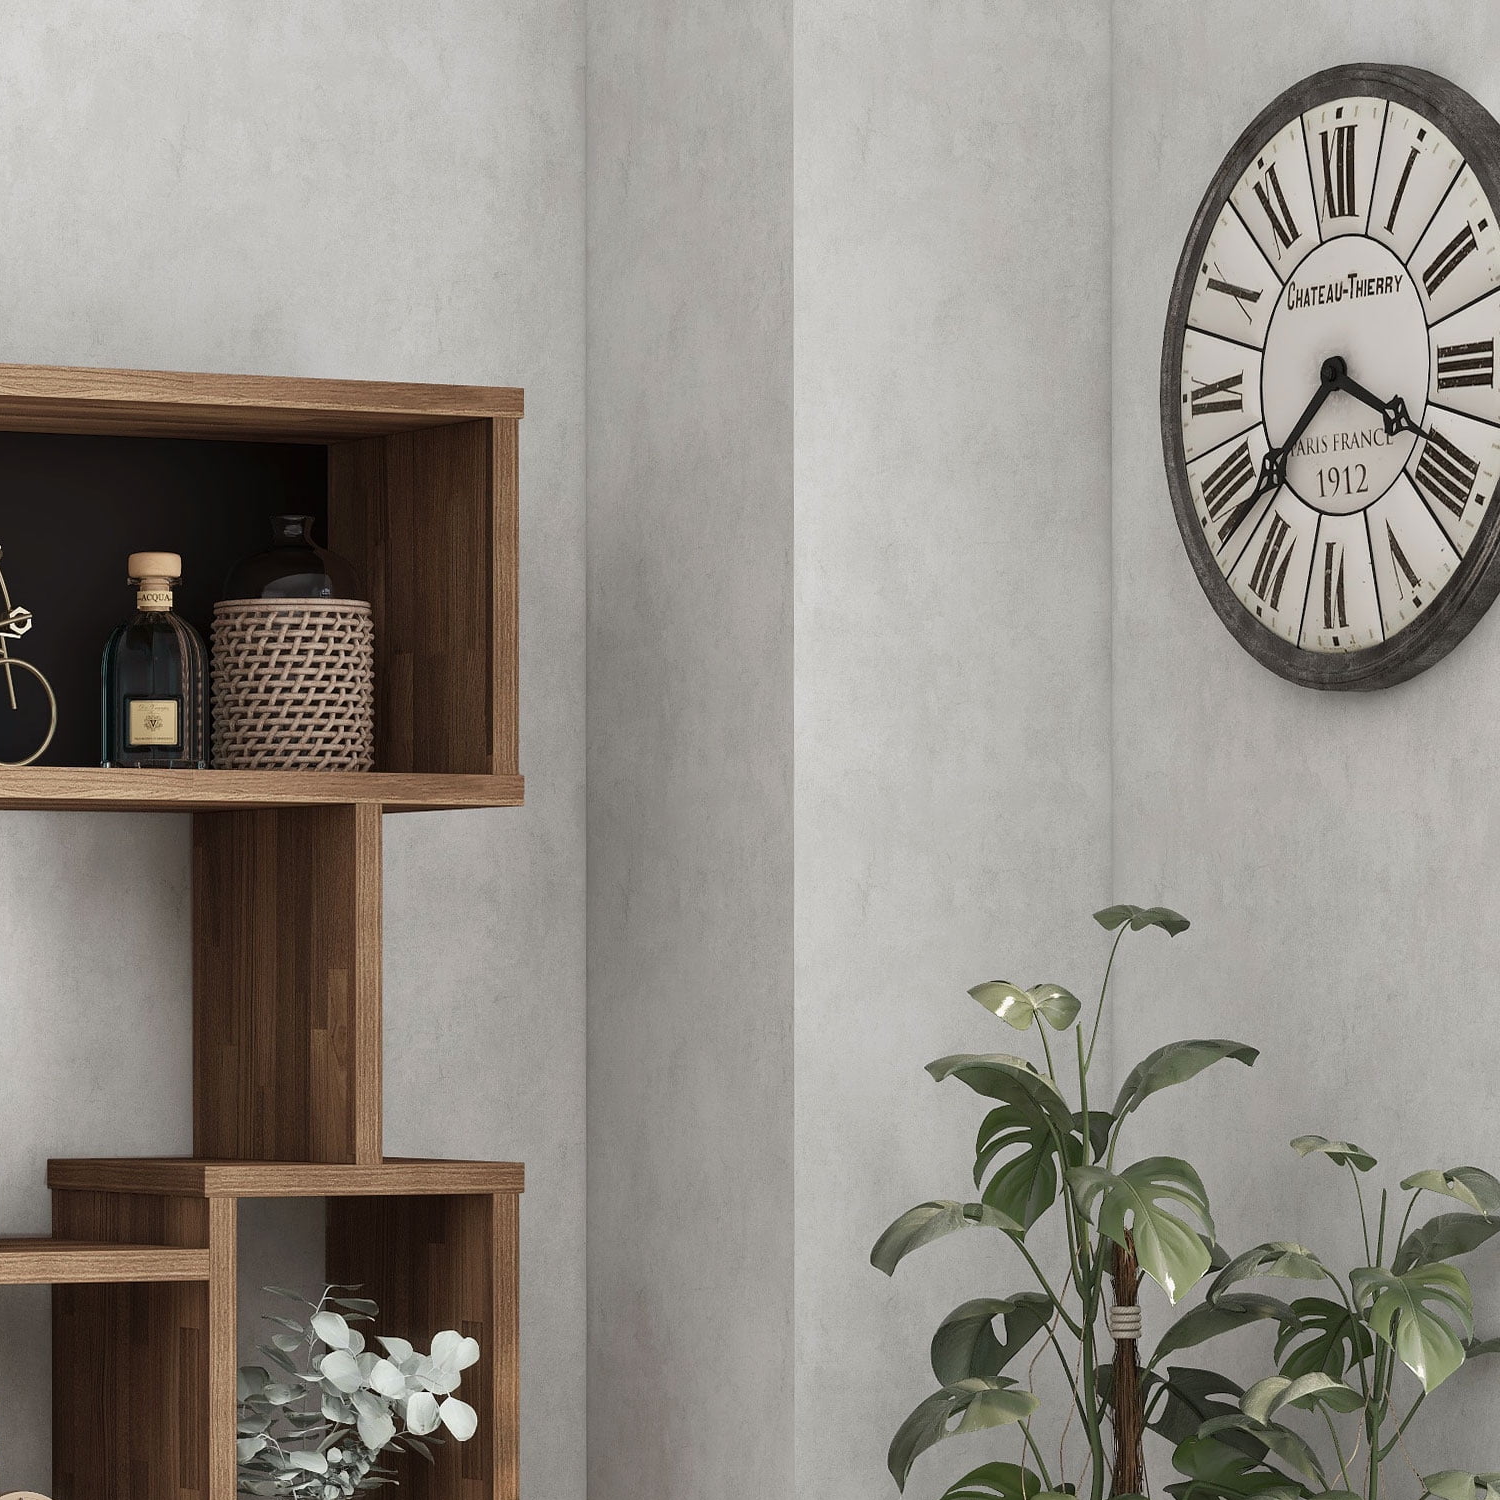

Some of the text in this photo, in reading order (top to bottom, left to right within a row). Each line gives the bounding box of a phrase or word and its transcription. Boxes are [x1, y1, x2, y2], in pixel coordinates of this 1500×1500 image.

[1319, 124, 1360, 223] XII
[1287, 273, 1404, 311] CHATEAU-THIERRY
[1316, 463, 1369, 498] 1912
[141, 593, 170, 602] ACQUA
